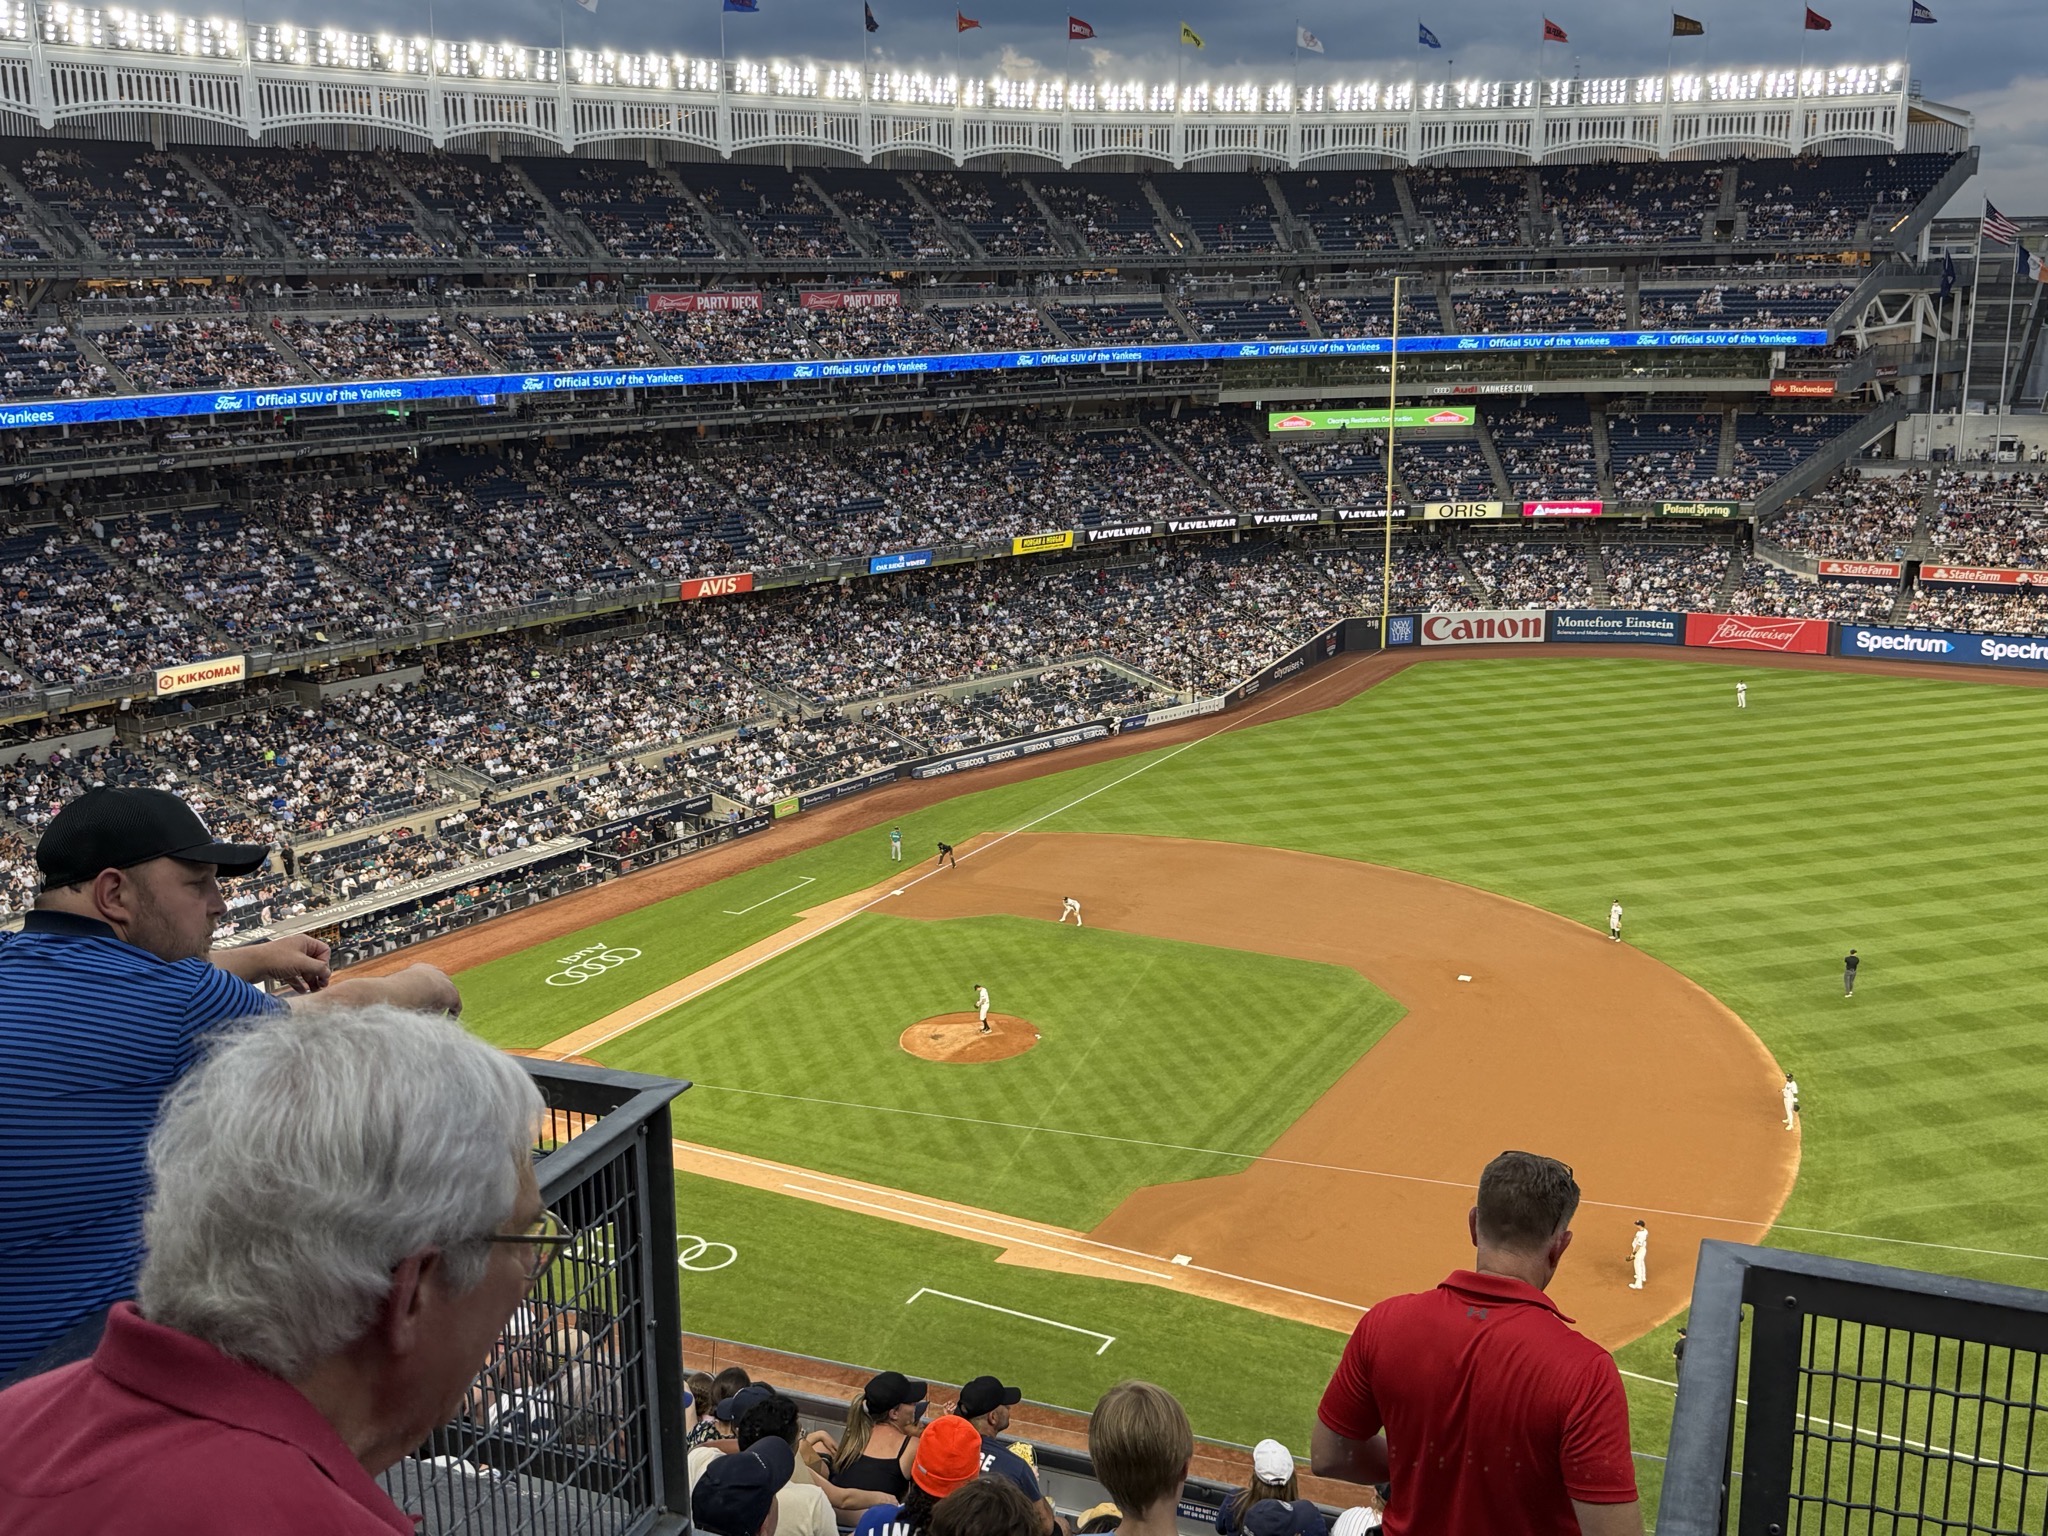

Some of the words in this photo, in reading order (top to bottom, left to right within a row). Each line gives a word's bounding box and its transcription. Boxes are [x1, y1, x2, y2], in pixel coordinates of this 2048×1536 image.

[697, 296, 729, 310] PARTY
[732, 296, 759, 309] DECK
[843, 295, 871, 308] PARTY
[874, 294, 898, 306] DECK
[1458, 339, 1479, 349] Ford
[1489, 337, 1521, 348] Official
[1523, 337, 1542, 347] SUV
[1544, 336, 1555, 346] of
[1556, 336, 1572, 346] the
[1574, 336, 1610, 345] Yankees
[1636, 334, 1660, 346] Ford
[1670, 334, 1704, 345] Official
[1705, 334, 1726, 344] SUV
[1728, 333, 1739, 344] of
[1740, 333, 1756, 343] the
[1758, 333, 1797, 344] Yankees
[1240, 345, 1259, 356] Ford
[1269, 344, 1298, 355] Official
[1300, 343, 1318, 353] SUV
[1319, 343, 1329, 353] of
[1330, 343, 1344, 352] the
[1345, 342, 1381, 352] Yankees
[1017, 355, 1034, 366] Ford
[1041, 353, 1069, 364] Official
[1070, 353, 1087, 363] SUV
[1088, 352, 1097, 362] of
[1097, 352, 1110, 361] the
[1112, 351, 1142, 361] Yankees
[793, 365, 813, 378] Ford
[822, 363, 852, 376] Official
[853, 363, 871, 374] SUV
[872, 362, 881, 373] of
[882, 361, 896, 372] the
[897, 361, 928, 371] Yankees
[522, 377, 544, 390] Ford
[553, 376, 591, 388] Official
[592, 375, 613, 386] SUV
[615, 373, 627, 385] of
[628, 373, 644, 384] the
[646, 372, 684, 383] Yankees
[1453, 386, 1478, 394] Audi
[1481, 385, 1513, 393] YANKEES
[1515, 384, 1533, 393] CLUB
[1789, 385, 1833, 394] Budweiser
[214, 396, 243, 410] Ford
[256, 394, 298, 407] Official
[300, 391, 323, 403] SUV
[326, 390, 339, 402] of
[340, 389, 358, 400] the
[360, 387, 402, 399] Yankees
[0, 411, 54, 424] Yankees
[1439, 504, 1486, 518] ORIS
[1663, 504, 1696, 515] Poland
[1697, 504, 1730, 517] Spring
[1178, 518, 1236, 531] LEVELWEAR
[1263, 513, 1318, 524] LEVELWEAR
[1098, 525, 1151, 540] LEVELWEAR
[698, 578, 737, 597] AVIS
[1393, 621, 1410, 629] NEW
[1423, 616, 1542, 641] Canon
[1557, 616, 1623, 628] Montefiore
[1625, 617, 1674, 630] Einstein
[1391, 627, 1411, 635] YORK
[1393, 633, 1408, 641] LIFE
[1718, 622, 1793, 641] Budweiser
[1856, 631, 1947, 653] Spectrum
[177, 664, 241, 685] KIKKOMAN
[439, 860, 500, 880] Welcome
[375, 879, 430, 899] Yankee
[313, 897, 374, 918] Stadium
[556, 942, 608, 965] Audi
